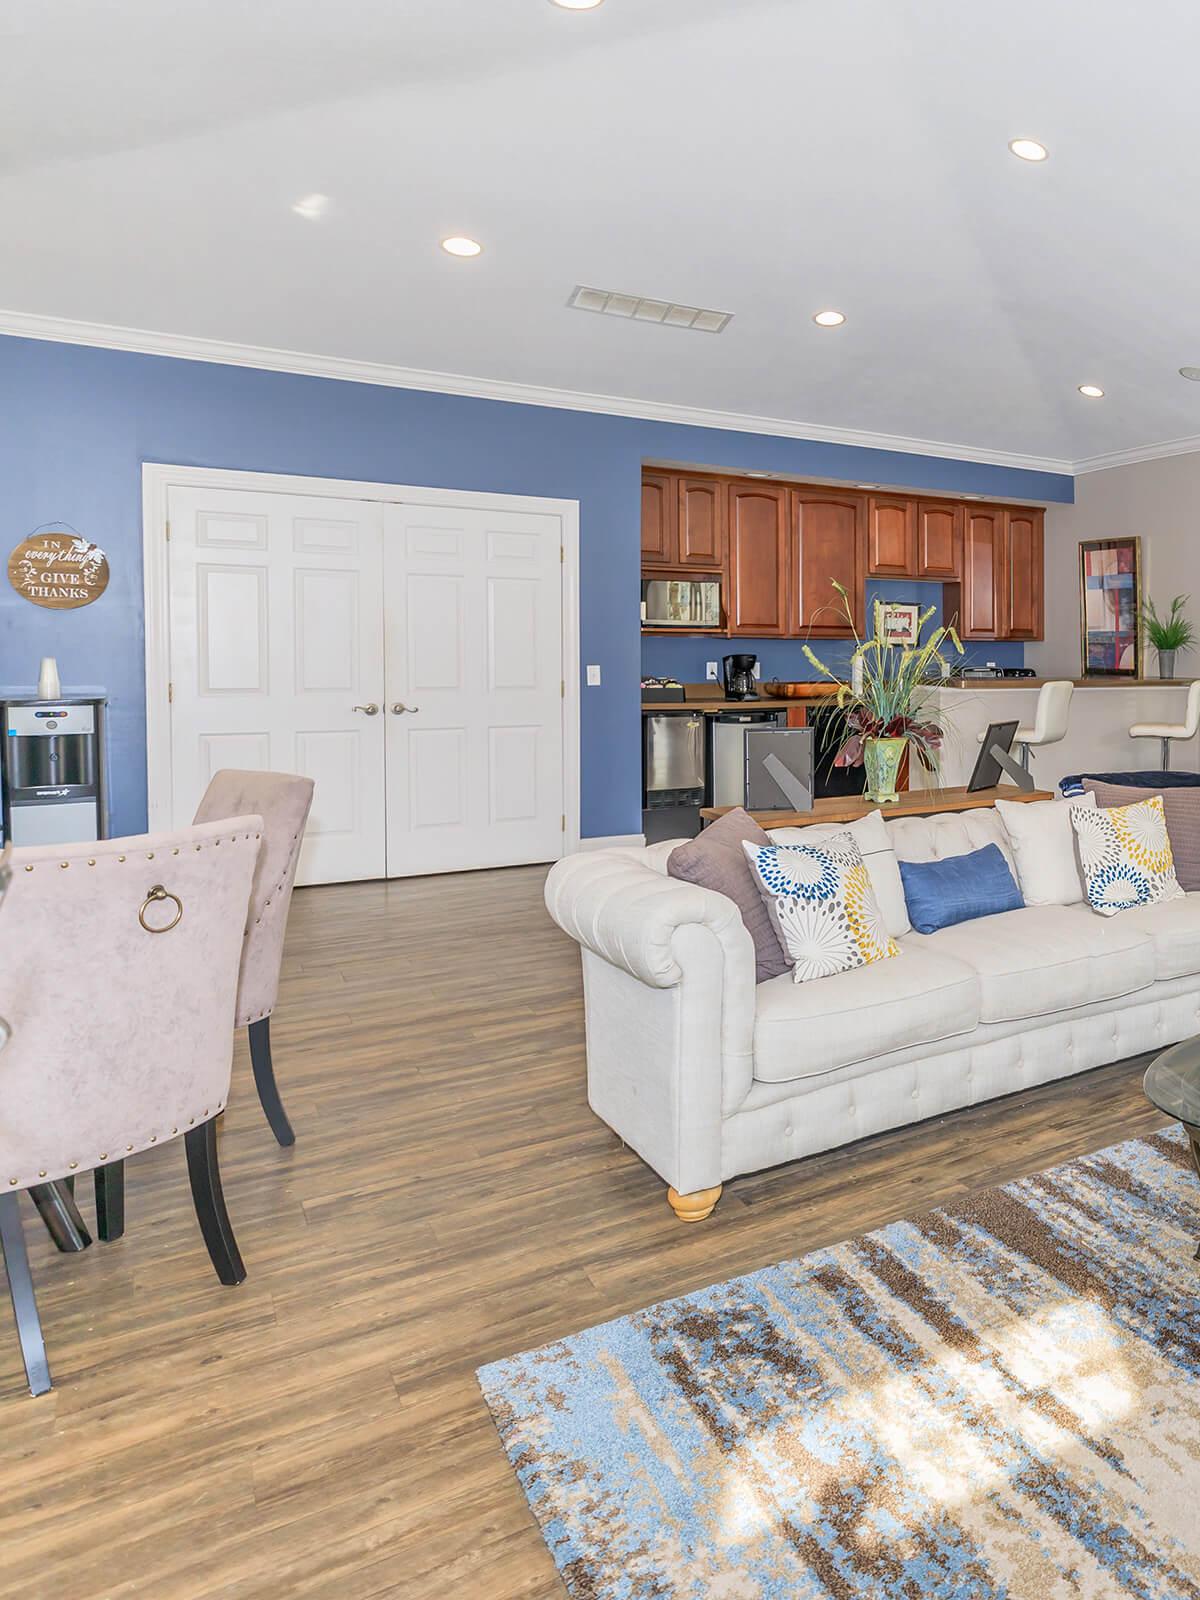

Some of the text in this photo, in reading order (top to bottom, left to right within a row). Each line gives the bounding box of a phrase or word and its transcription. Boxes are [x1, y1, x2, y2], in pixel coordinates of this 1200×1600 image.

[41, 540, 61, 548] IN
[25, 545, 89, 569] everything
[40, 572, 80, 584] GIVE
[28, 585, 89, 598] THANKS
